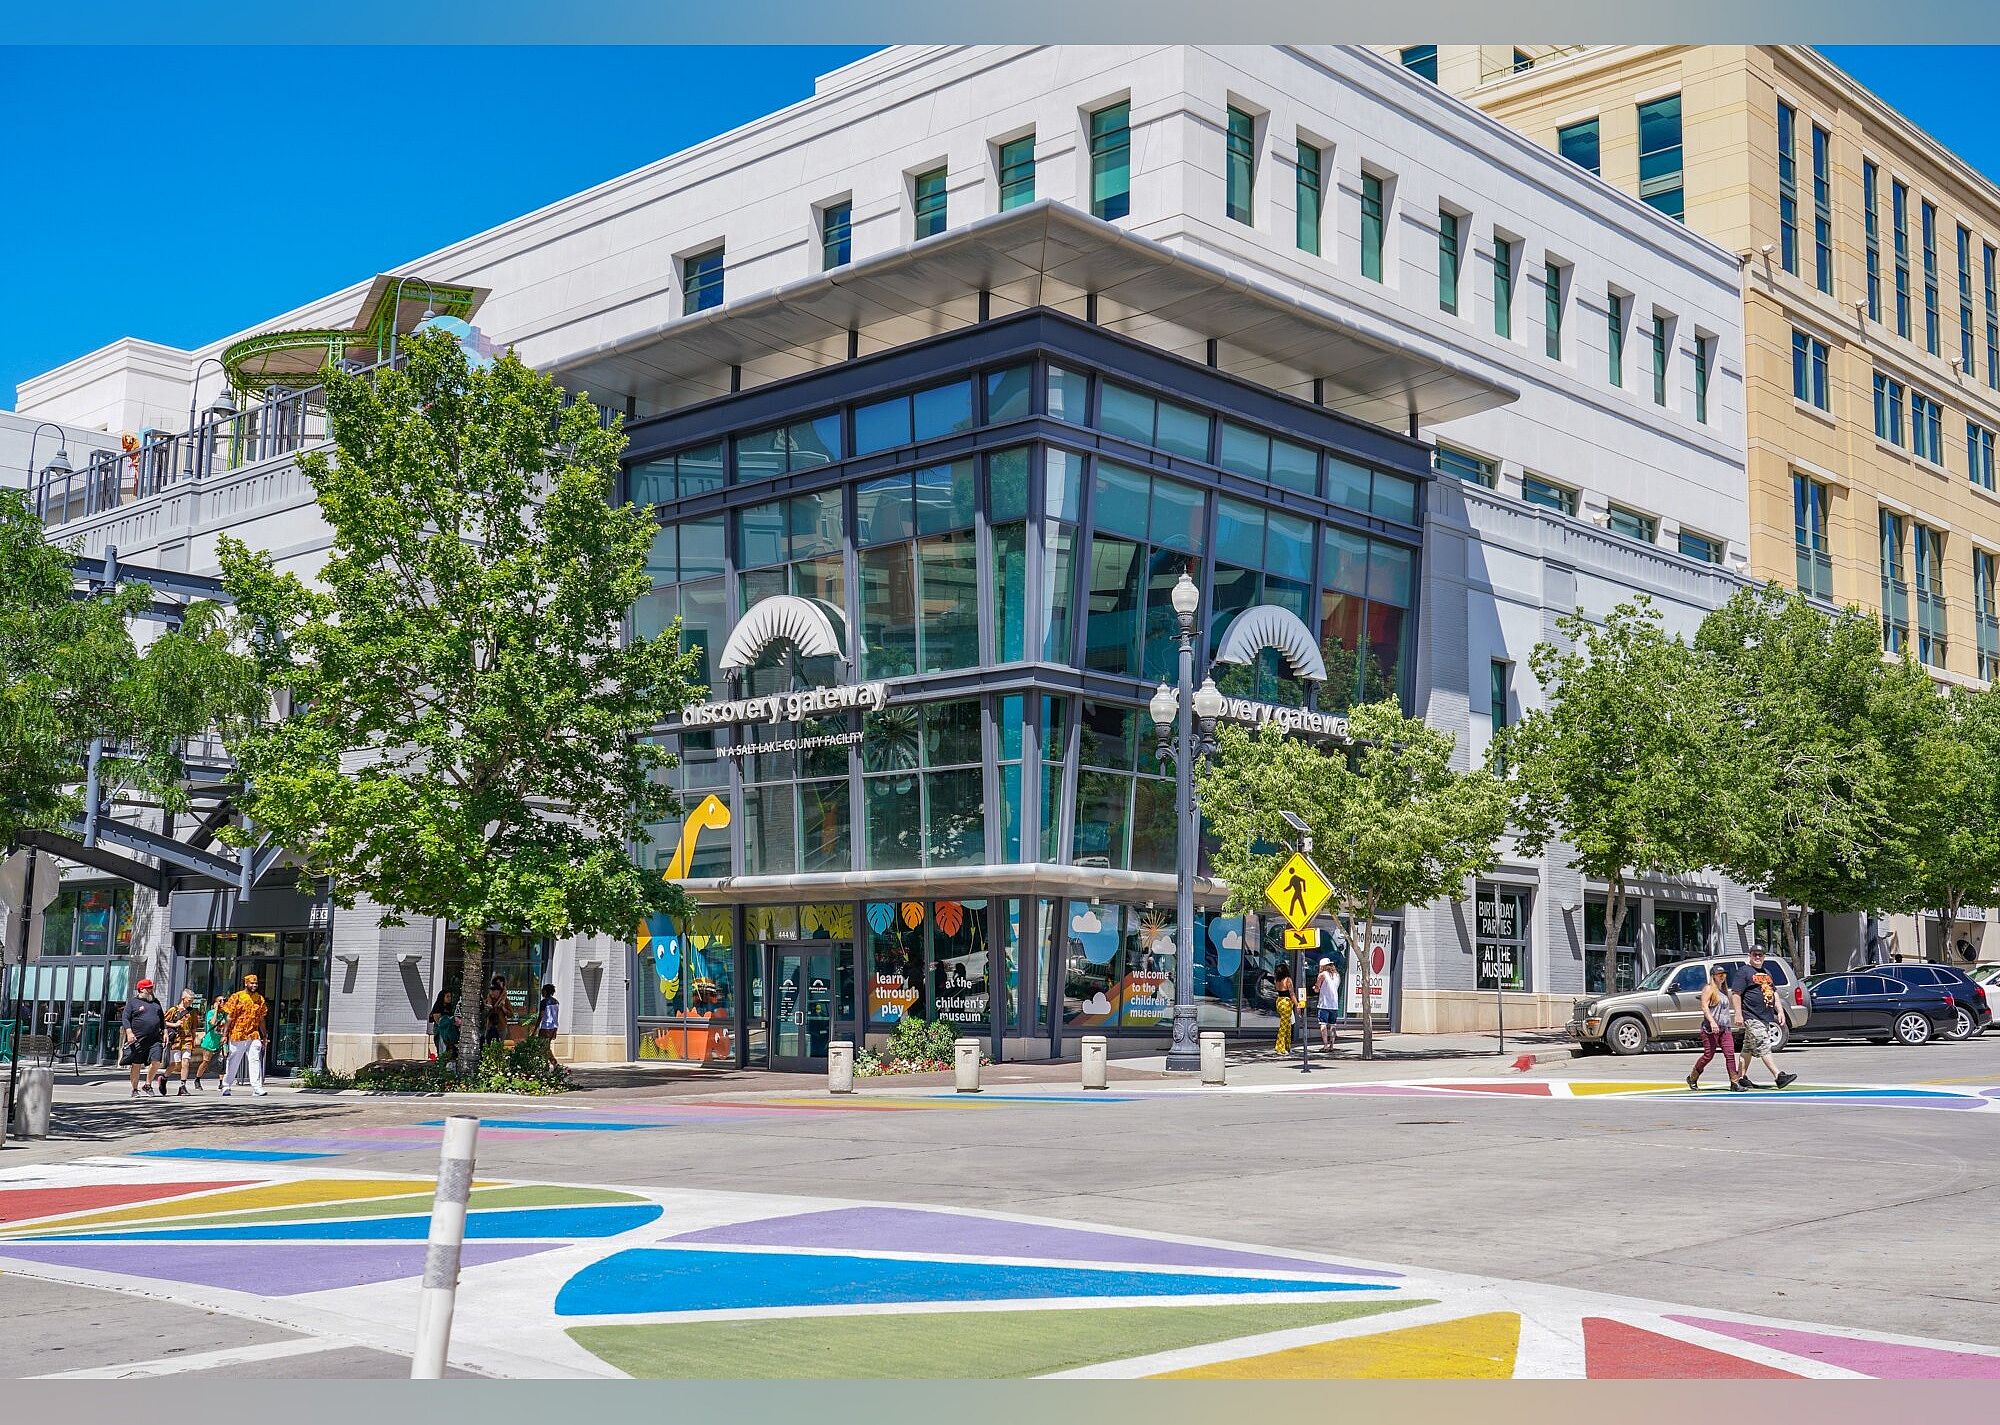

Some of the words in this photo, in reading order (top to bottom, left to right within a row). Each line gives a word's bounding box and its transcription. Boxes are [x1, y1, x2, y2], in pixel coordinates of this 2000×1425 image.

[682, 697, 781, 726] discovery
[788, 683, 888, 721] gateway
[1275, 706, 1352, 738] gatewa
[716, 747, 726, 758] IN
[727, 746, 736, 756] A
[736, 743, 756, 756] SALT
[758, 741, 782, 753] LAKE
[783, 737, 823, 750] COUNTY
[824, 731, 864, 746] FACILITY
[1478, 901, 1515, 919] BIRTDAY
[1482, 918, 1512, 935] PARIES
[1484, 945, 1494, 961] AT
[876, 972, 904, 985] learn
[1132, 969, 1169, 980] welcome
[945, 980, 955, 989] at
[956, 976, 972, 989] the
[1132, 982, 1141, 992] to
[1142, 982, 1156, 993] the
[875, 986, 920, 1002] through
[1130, 995, 1171, 1006] children's
[881, 1002, 904, 1017] play
[935, 997, 984, 1009] children's
[939, 1012, 981, 1022] museum
[1130, 1009, 1165, 1018] museum
